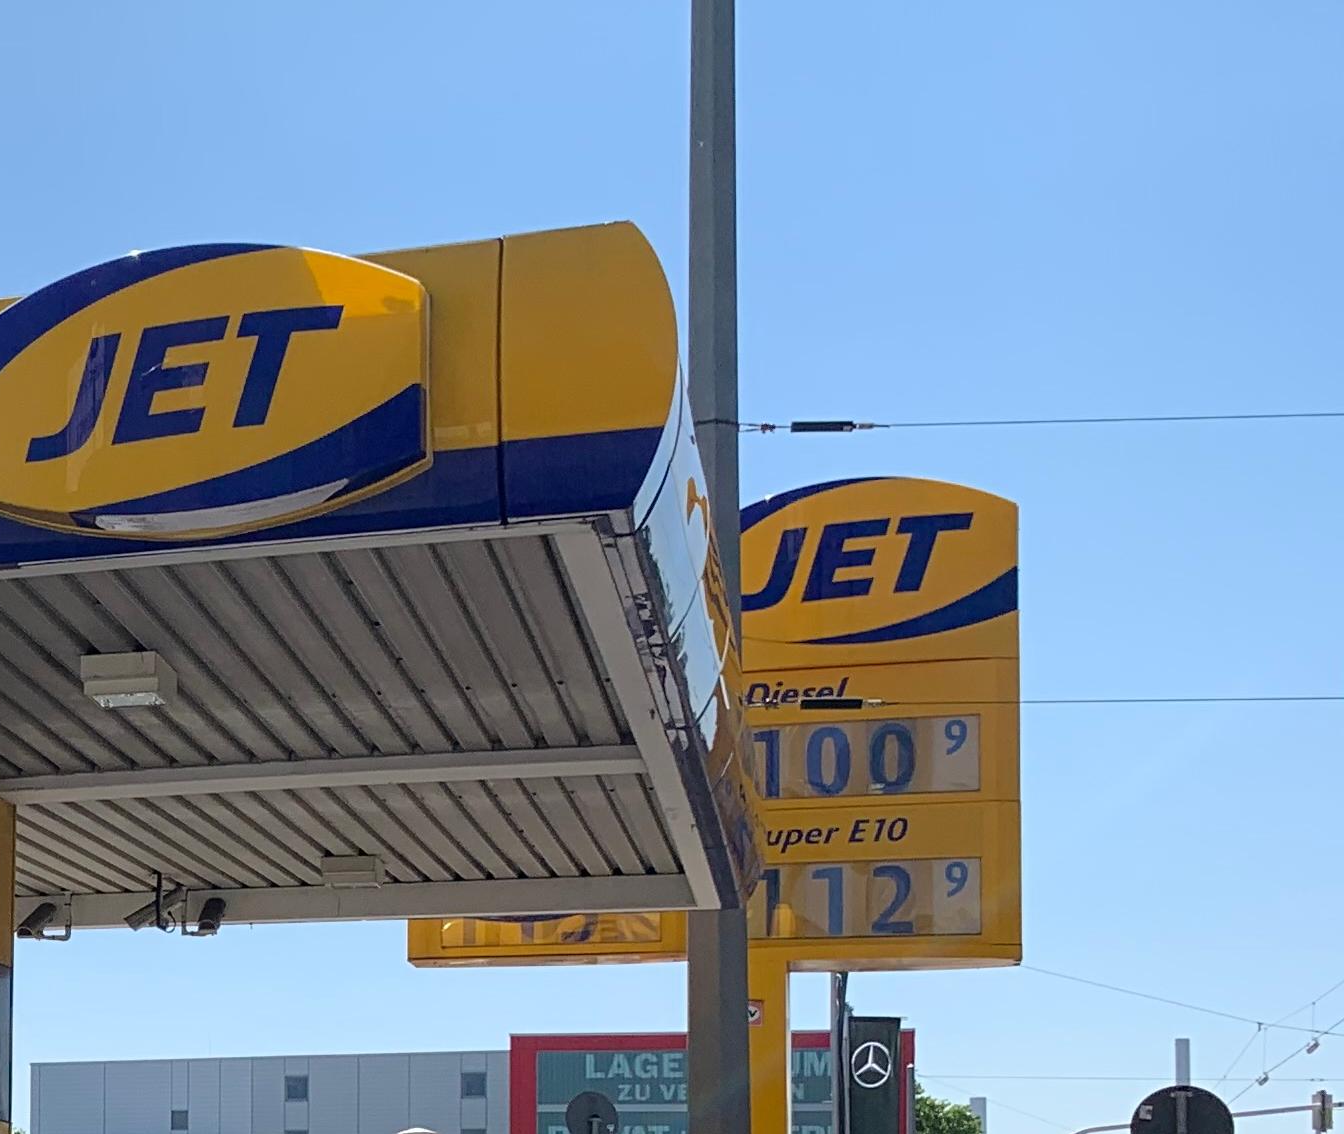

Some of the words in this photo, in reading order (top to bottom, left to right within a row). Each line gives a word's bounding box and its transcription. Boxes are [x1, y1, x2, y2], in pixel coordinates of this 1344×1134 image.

[25, 305, 344, 463] JET
[740, 513, 974, 611] JET
[746, 677, 849, 705] Diesel
[753, 722, 915, 798] 100
[944, 719, 968, 755] 9
[767, 826, 840, 853] uper
[848, 817, 908, 843] E10
[758, 865, 914, 937] 112
[944, 861, 968, 898] 9
[618, 1084, 650, 1101] ZU
